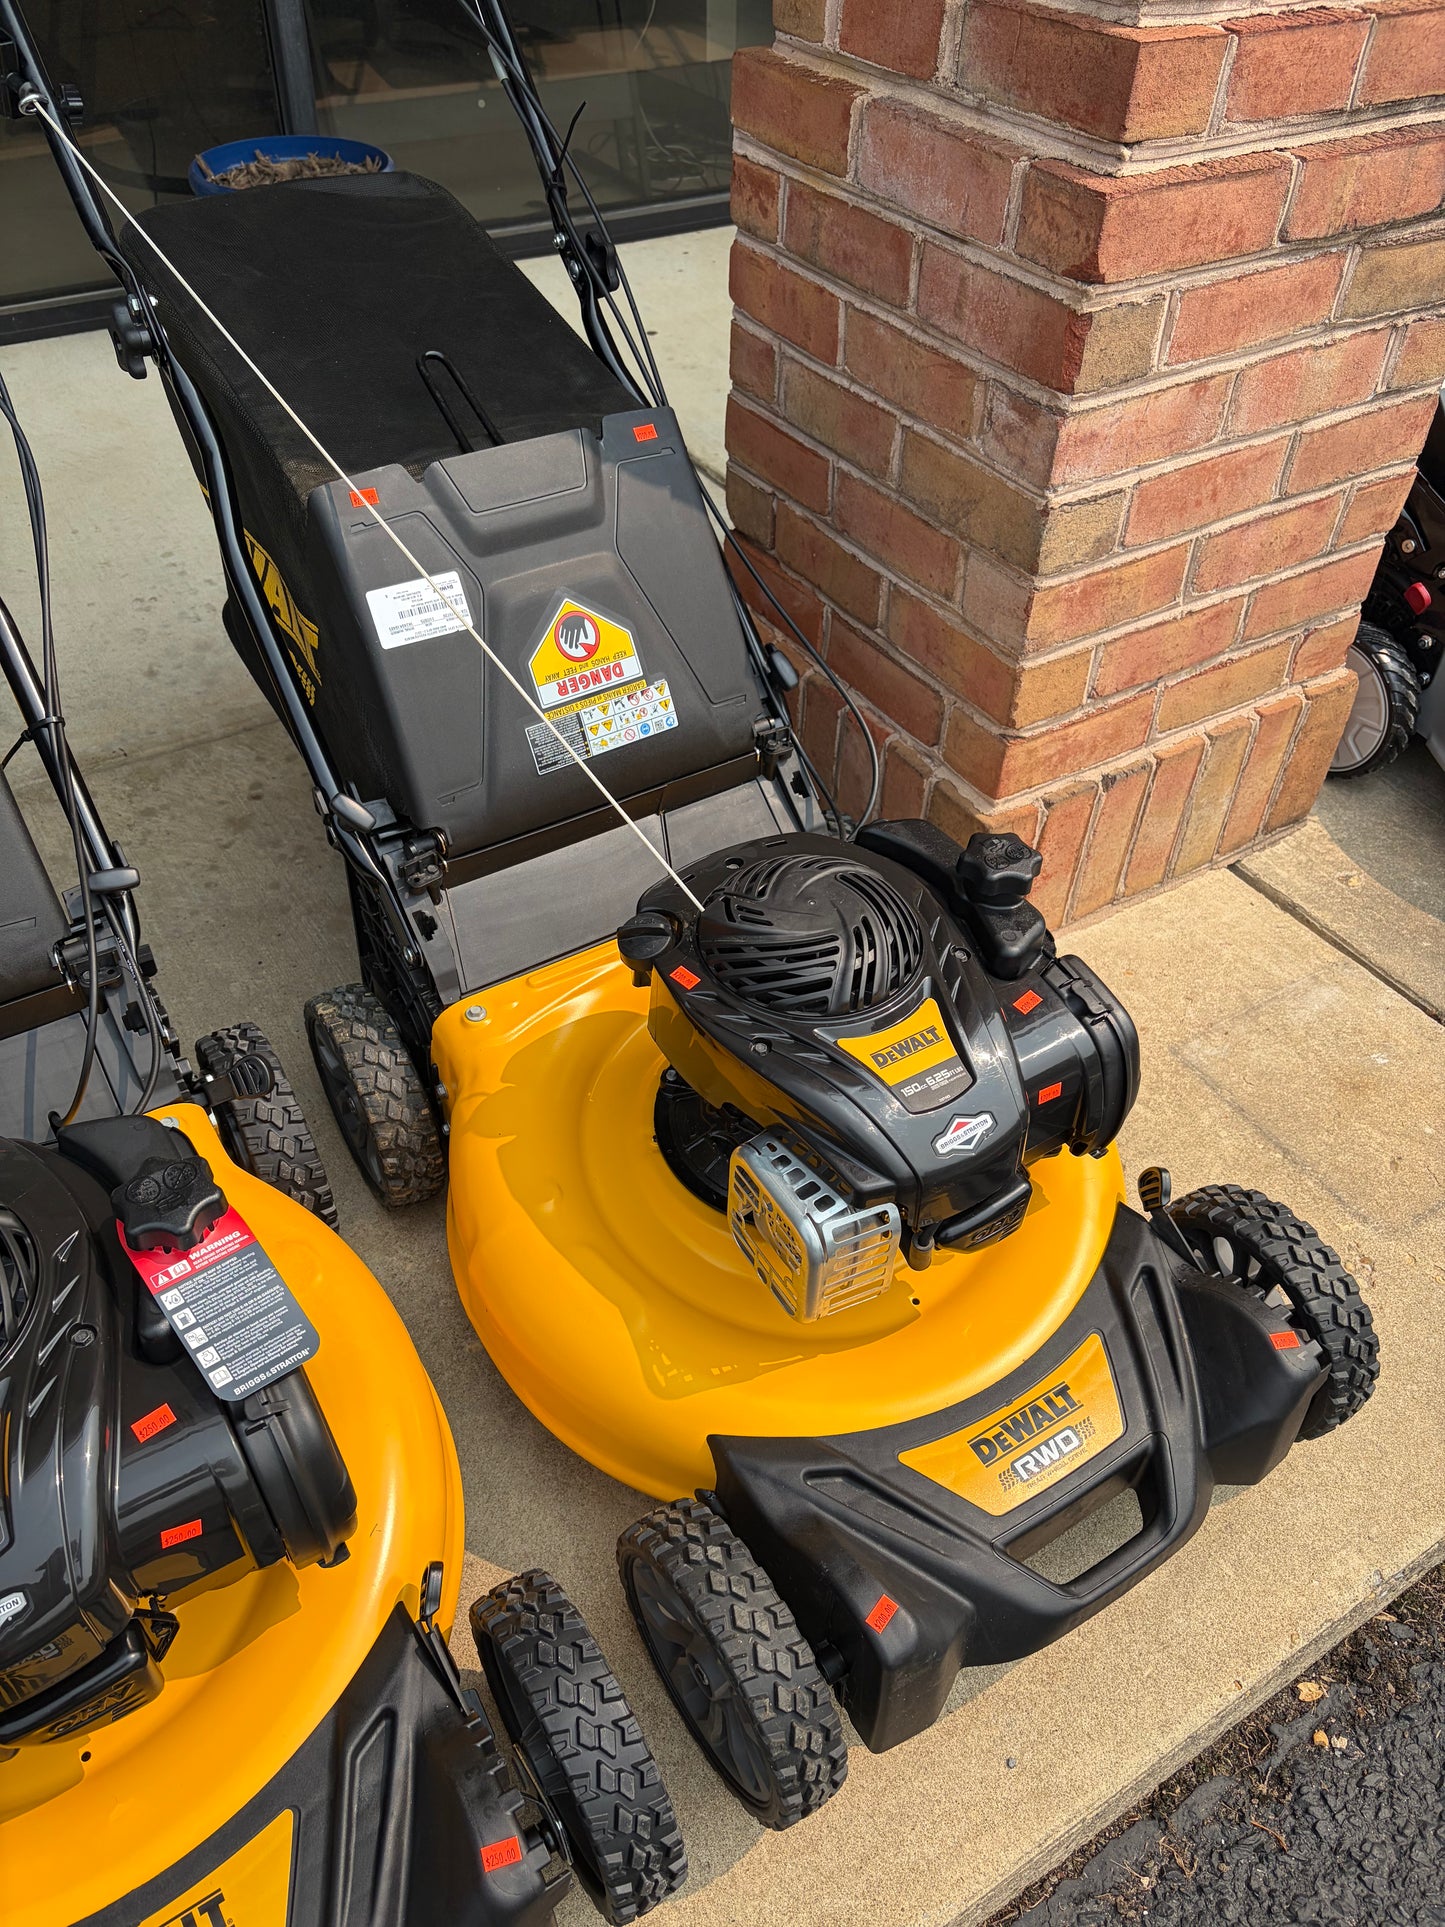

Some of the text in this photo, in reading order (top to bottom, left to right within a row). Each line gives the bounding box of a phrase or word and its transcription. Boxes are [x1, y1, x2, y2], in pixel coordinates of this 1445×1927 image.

[543, 650, 627, 682] KEEP HANDS and FEET AWAY
[554, 661, 625, 697] DANGER
[602, 688, 622, 700] MAINS
[546, 704, 574, 719] DISTANCE
[871, 1026, 943, 1069] DEWALT
[188, 1228, 241, 1262] WARNING
[139, 1413, 169, 1438] $250.00
[969, 1384, 1078, 1465] DEWALT
[1014, 1425, 1080, 1481] RWD
[164, 1527, 196, 1545] $250.00
[485, 1847, 515, 1867] $250.00
